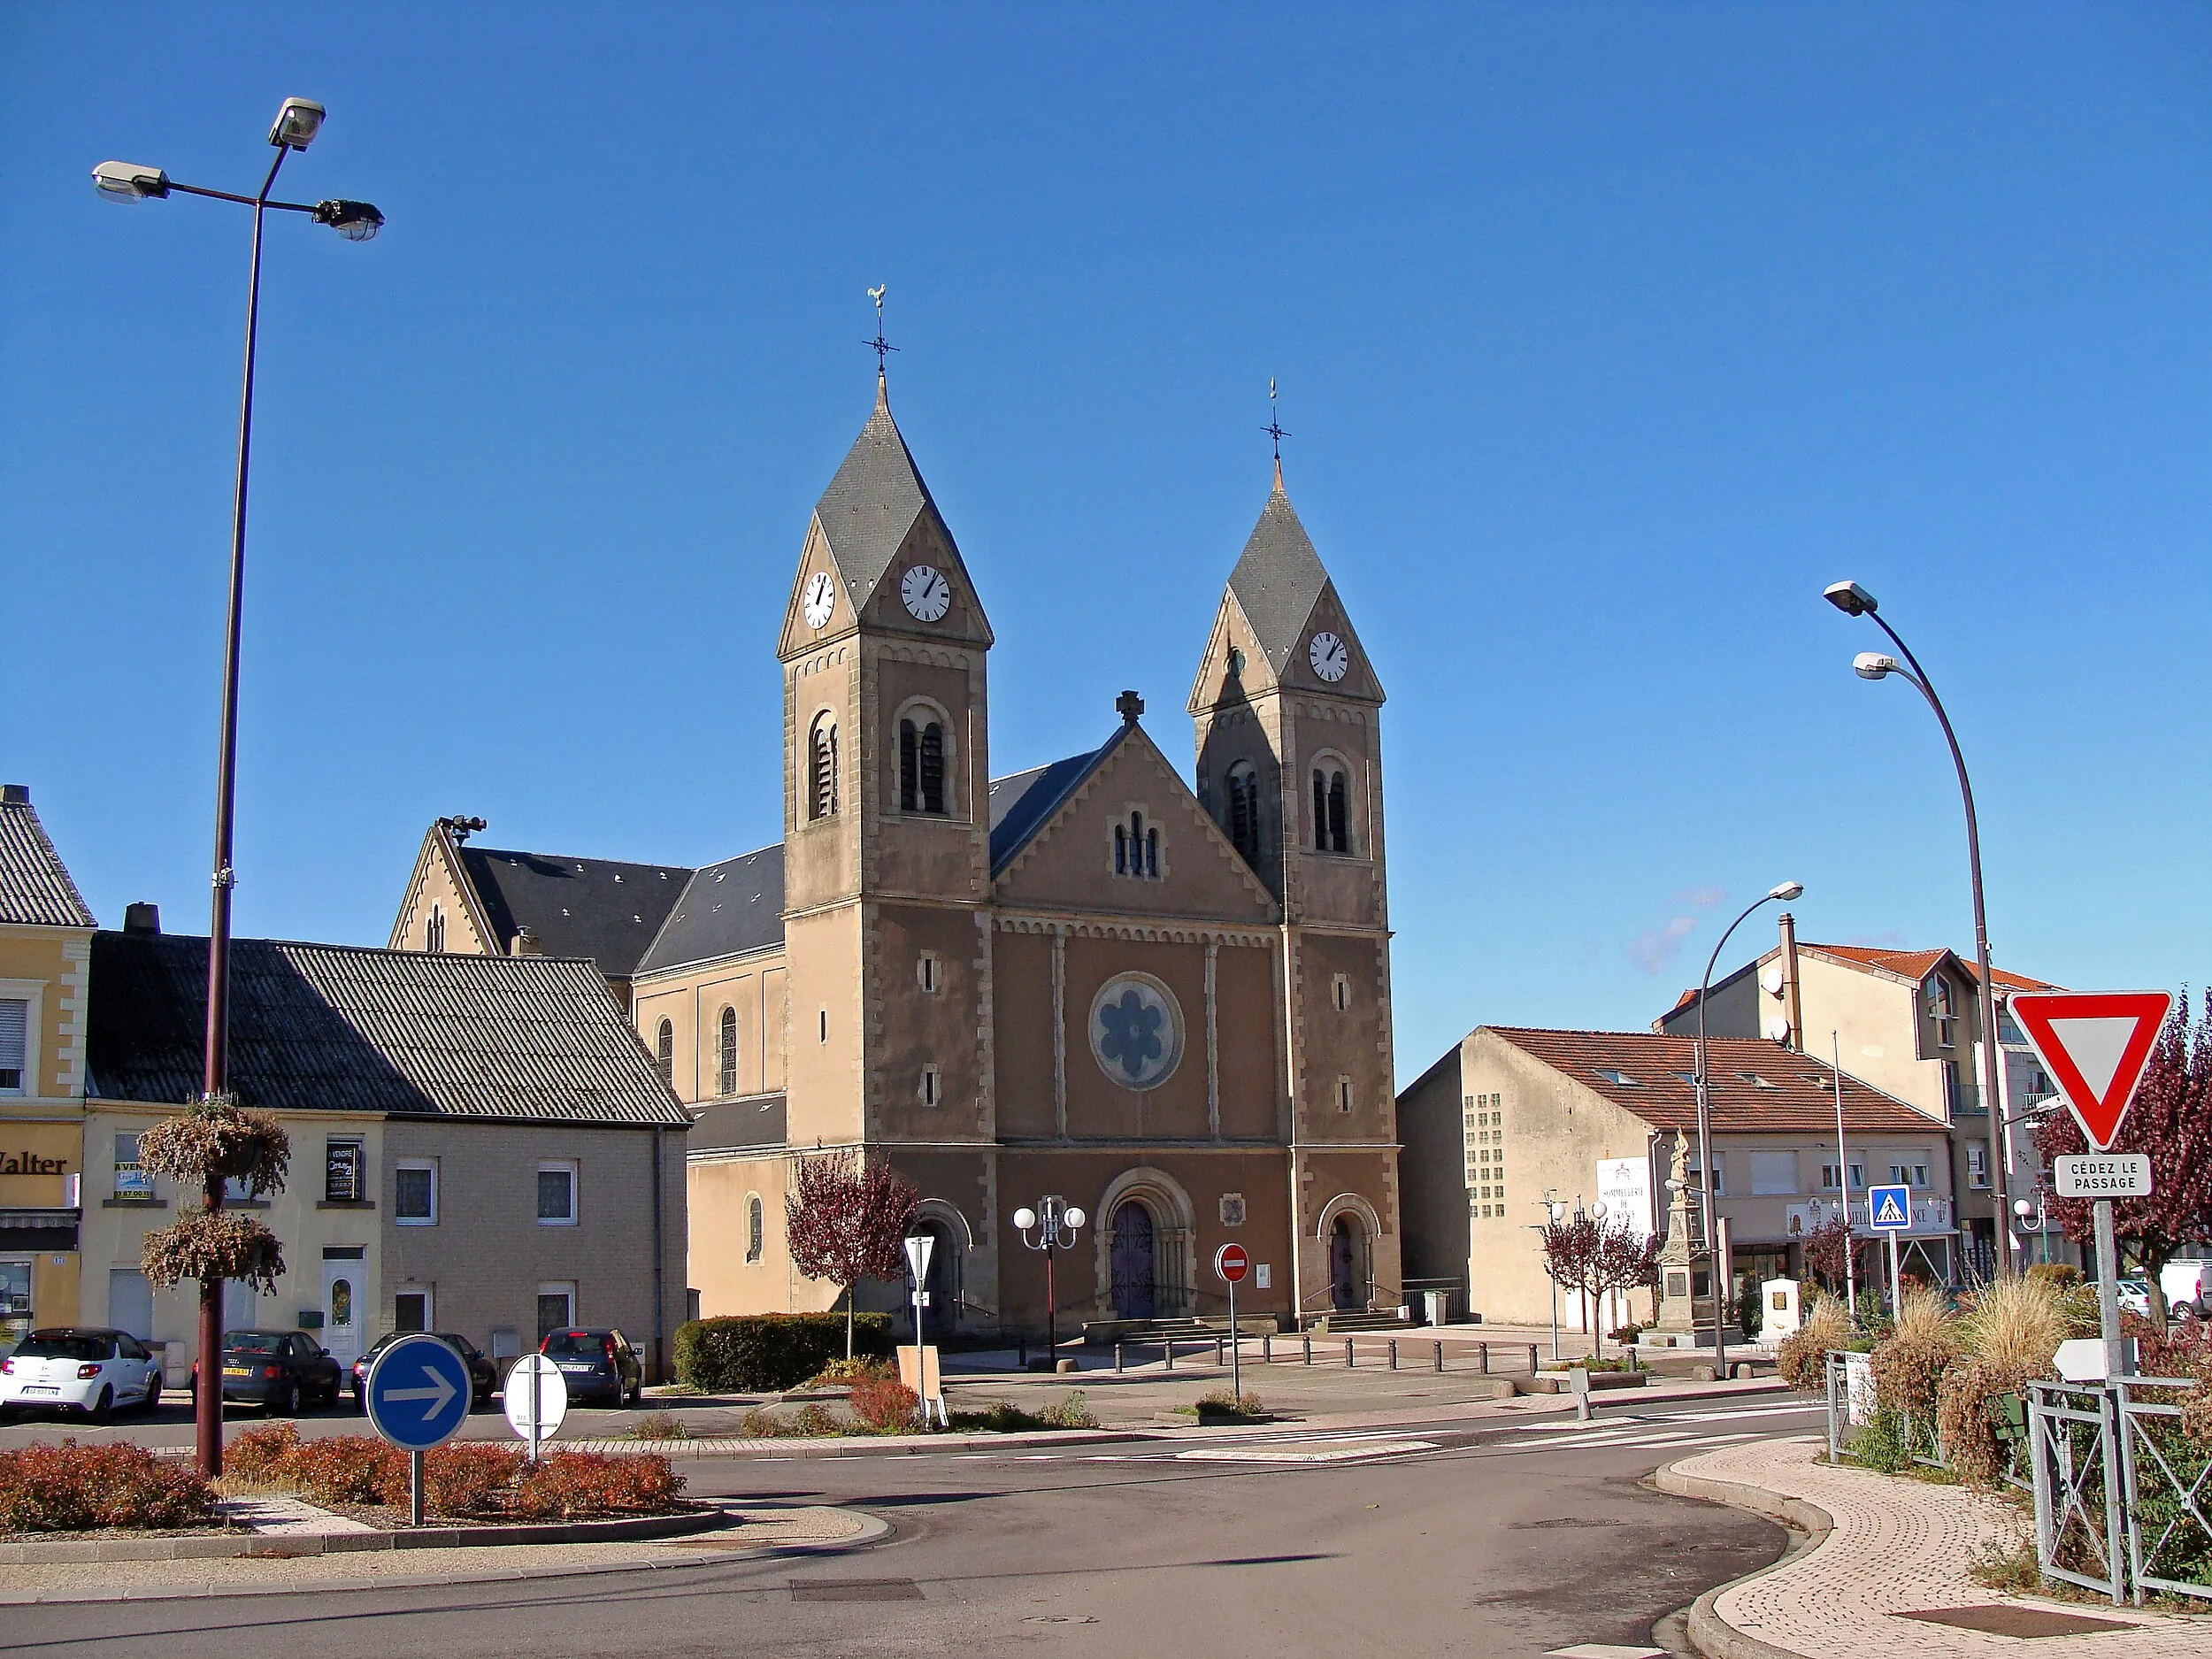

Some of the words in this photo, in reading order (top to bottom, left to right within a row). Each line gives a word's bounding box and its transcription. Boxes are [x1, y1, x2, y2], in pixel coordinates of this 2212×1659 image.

[2071, 1161, 2115, 1175] CÉDEZ
[2122, 1162, 2138, 1174] LE
[2075, 1177, 2136, 1189] PASSAGE
